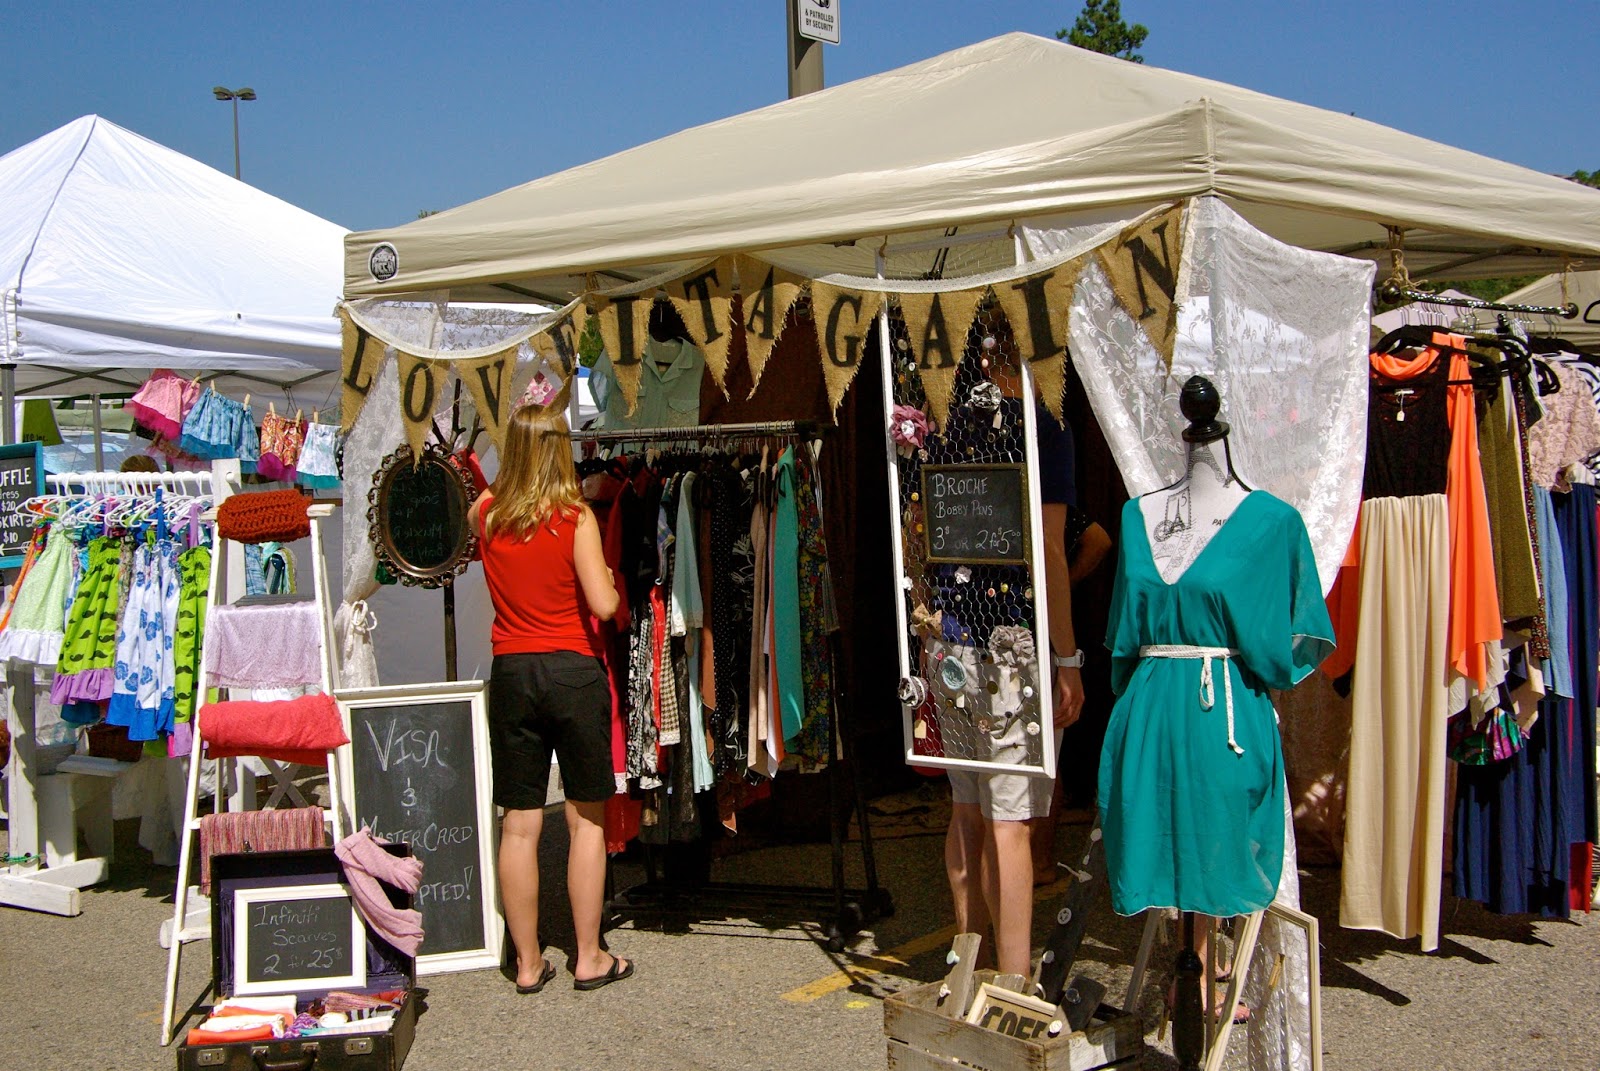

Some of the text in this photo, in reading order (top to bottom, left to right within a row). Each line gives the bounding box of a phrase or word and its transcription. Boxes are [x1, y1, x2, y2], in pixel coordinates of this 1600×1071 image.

[809, 9, 834, 23] PATROLLED
[806, 18, 834, 32] BY SECURITY
[932, 473, 988, 498] BROCHE
[1, 501, 16, 513] $20
[935, 501, 968, 519] BOBBY
[3, 531, 19, 544] $10
[975, 529, 989, 550] 2
[272, 928, 337, 947] Scarves
